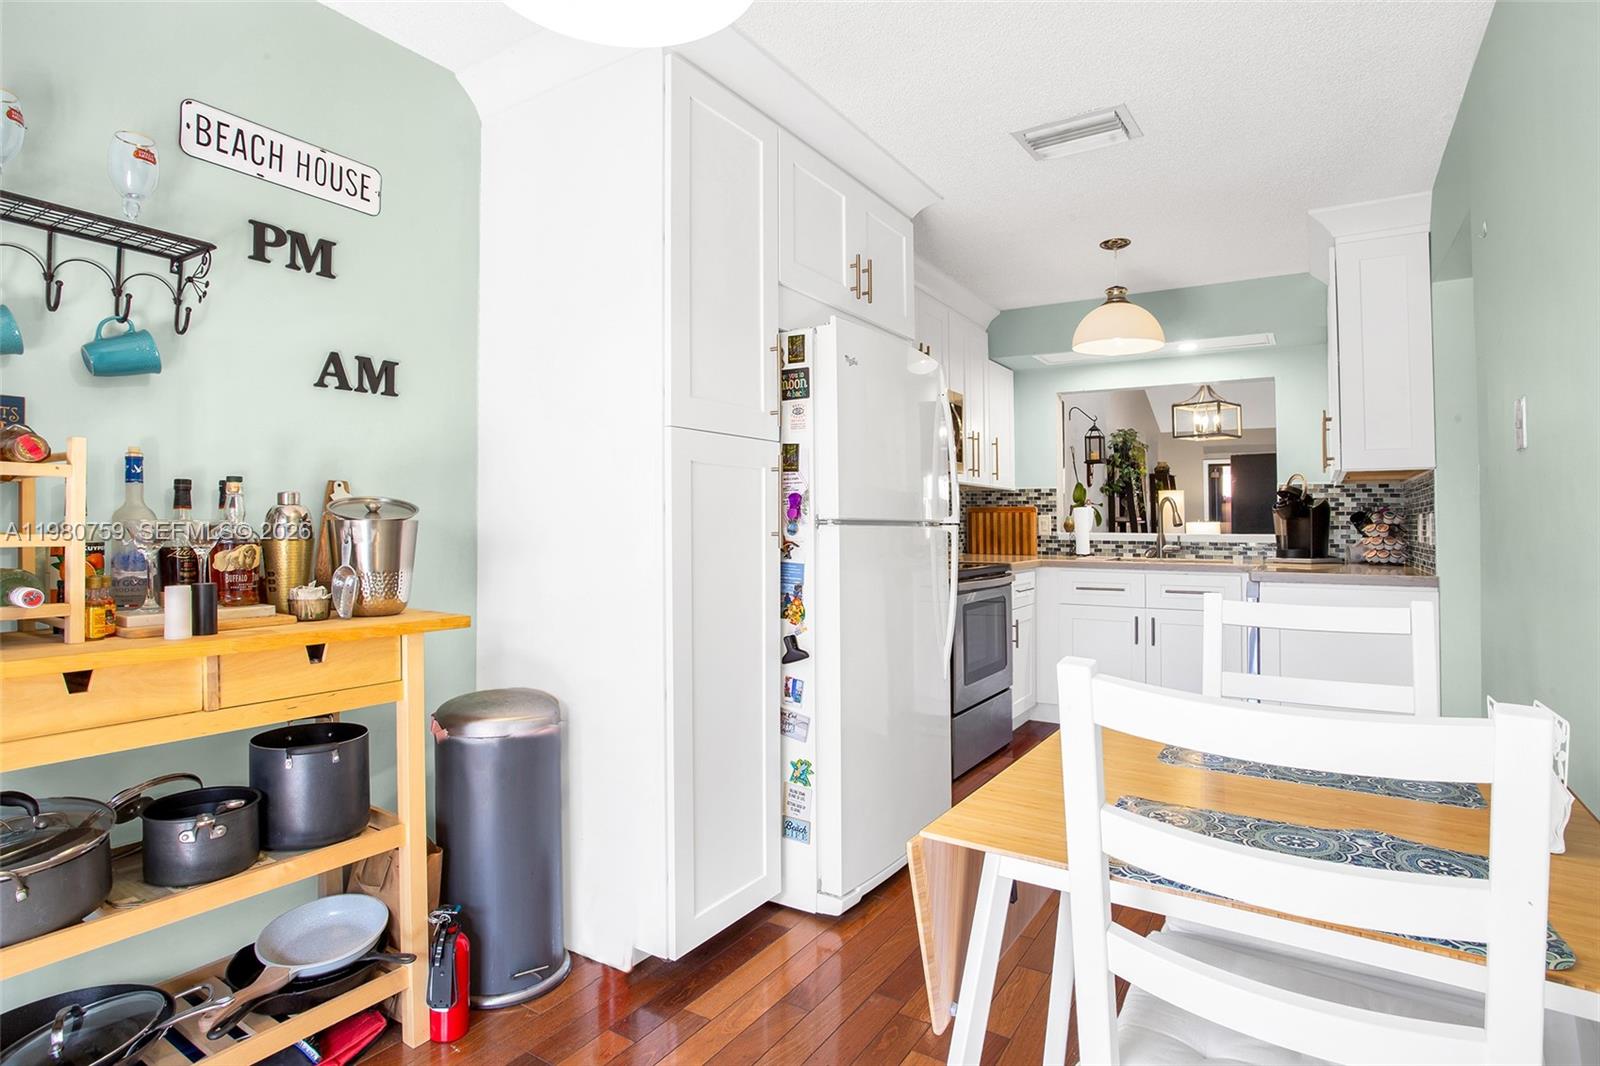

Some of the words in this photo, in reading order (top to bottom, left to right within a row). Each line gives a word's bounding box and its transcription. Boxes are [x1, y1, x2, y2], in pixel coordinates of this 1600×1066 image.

[195, 113, 284, 173] BEACH
[296, 149, 372, 203] HOUSE
[247, 218, 337, 279] PM
[313, 350, 399, 397] AM
